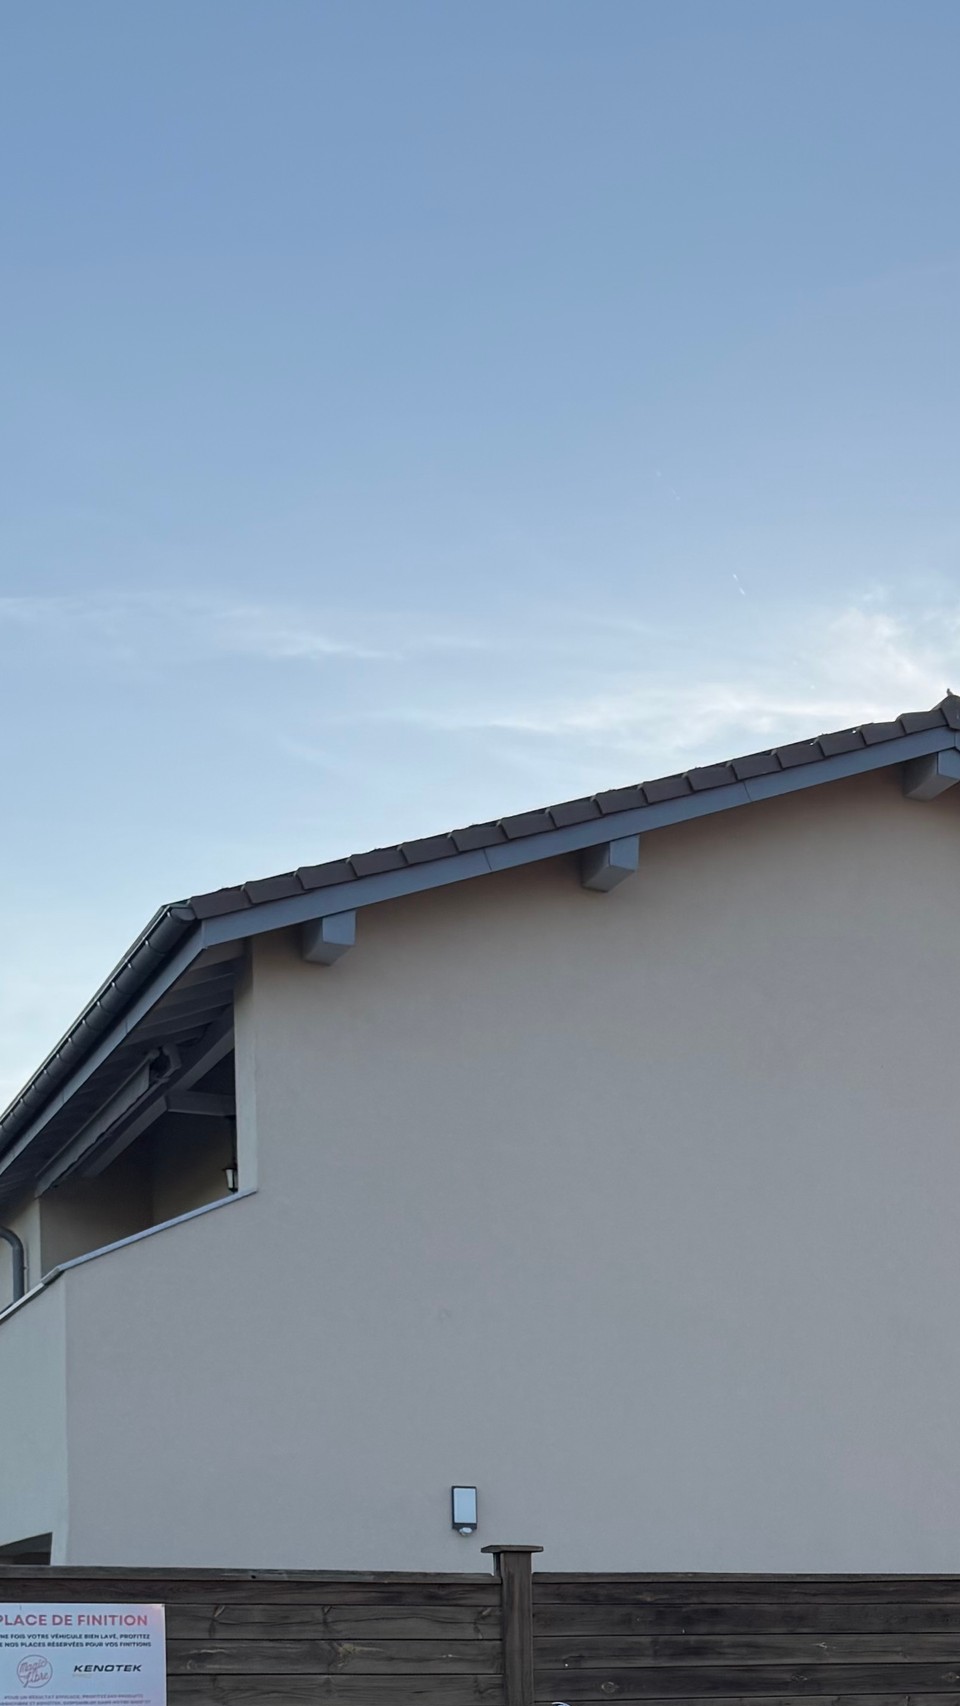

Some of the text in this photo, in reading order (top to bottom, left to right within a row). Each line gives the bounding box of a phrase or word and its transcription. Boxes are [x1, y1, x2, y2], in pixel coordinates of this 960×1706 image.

[52, 1614, 73, 1626] DE
[77, 1614, 148, 1626] FINITION
[73, 1664, 143, 1672] KENOTEK
